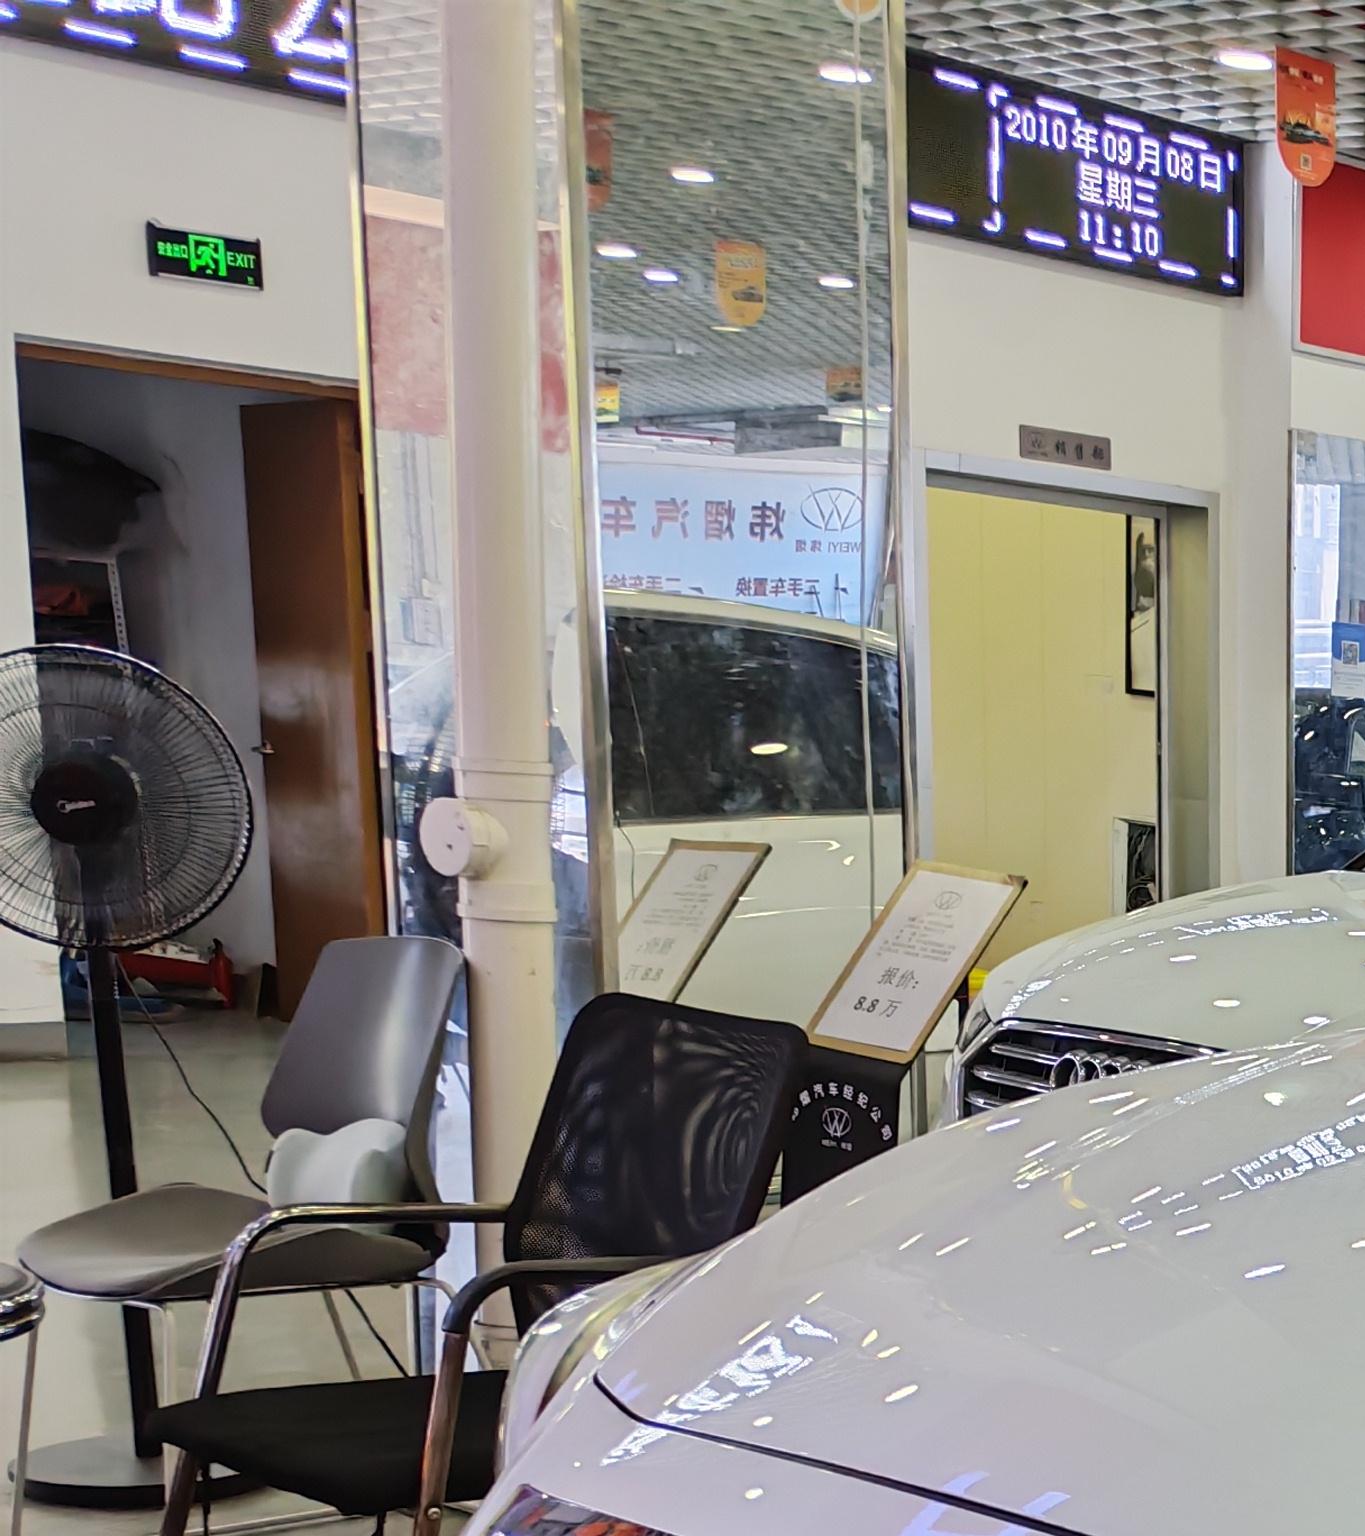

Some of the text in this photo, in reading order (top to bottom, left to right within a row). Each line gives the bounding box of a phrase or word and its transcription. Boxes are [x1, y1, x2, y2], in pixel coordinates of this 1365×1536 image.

[1004, 105, 1223, 193] 2010年09月08日
[1078, 160, 1159, 219] 星期三
[1078, 208, 1159, 257] 11:10
[227, 251, 256, 269] EXIT
[853, 996, 902, 1018] 8.8 万
